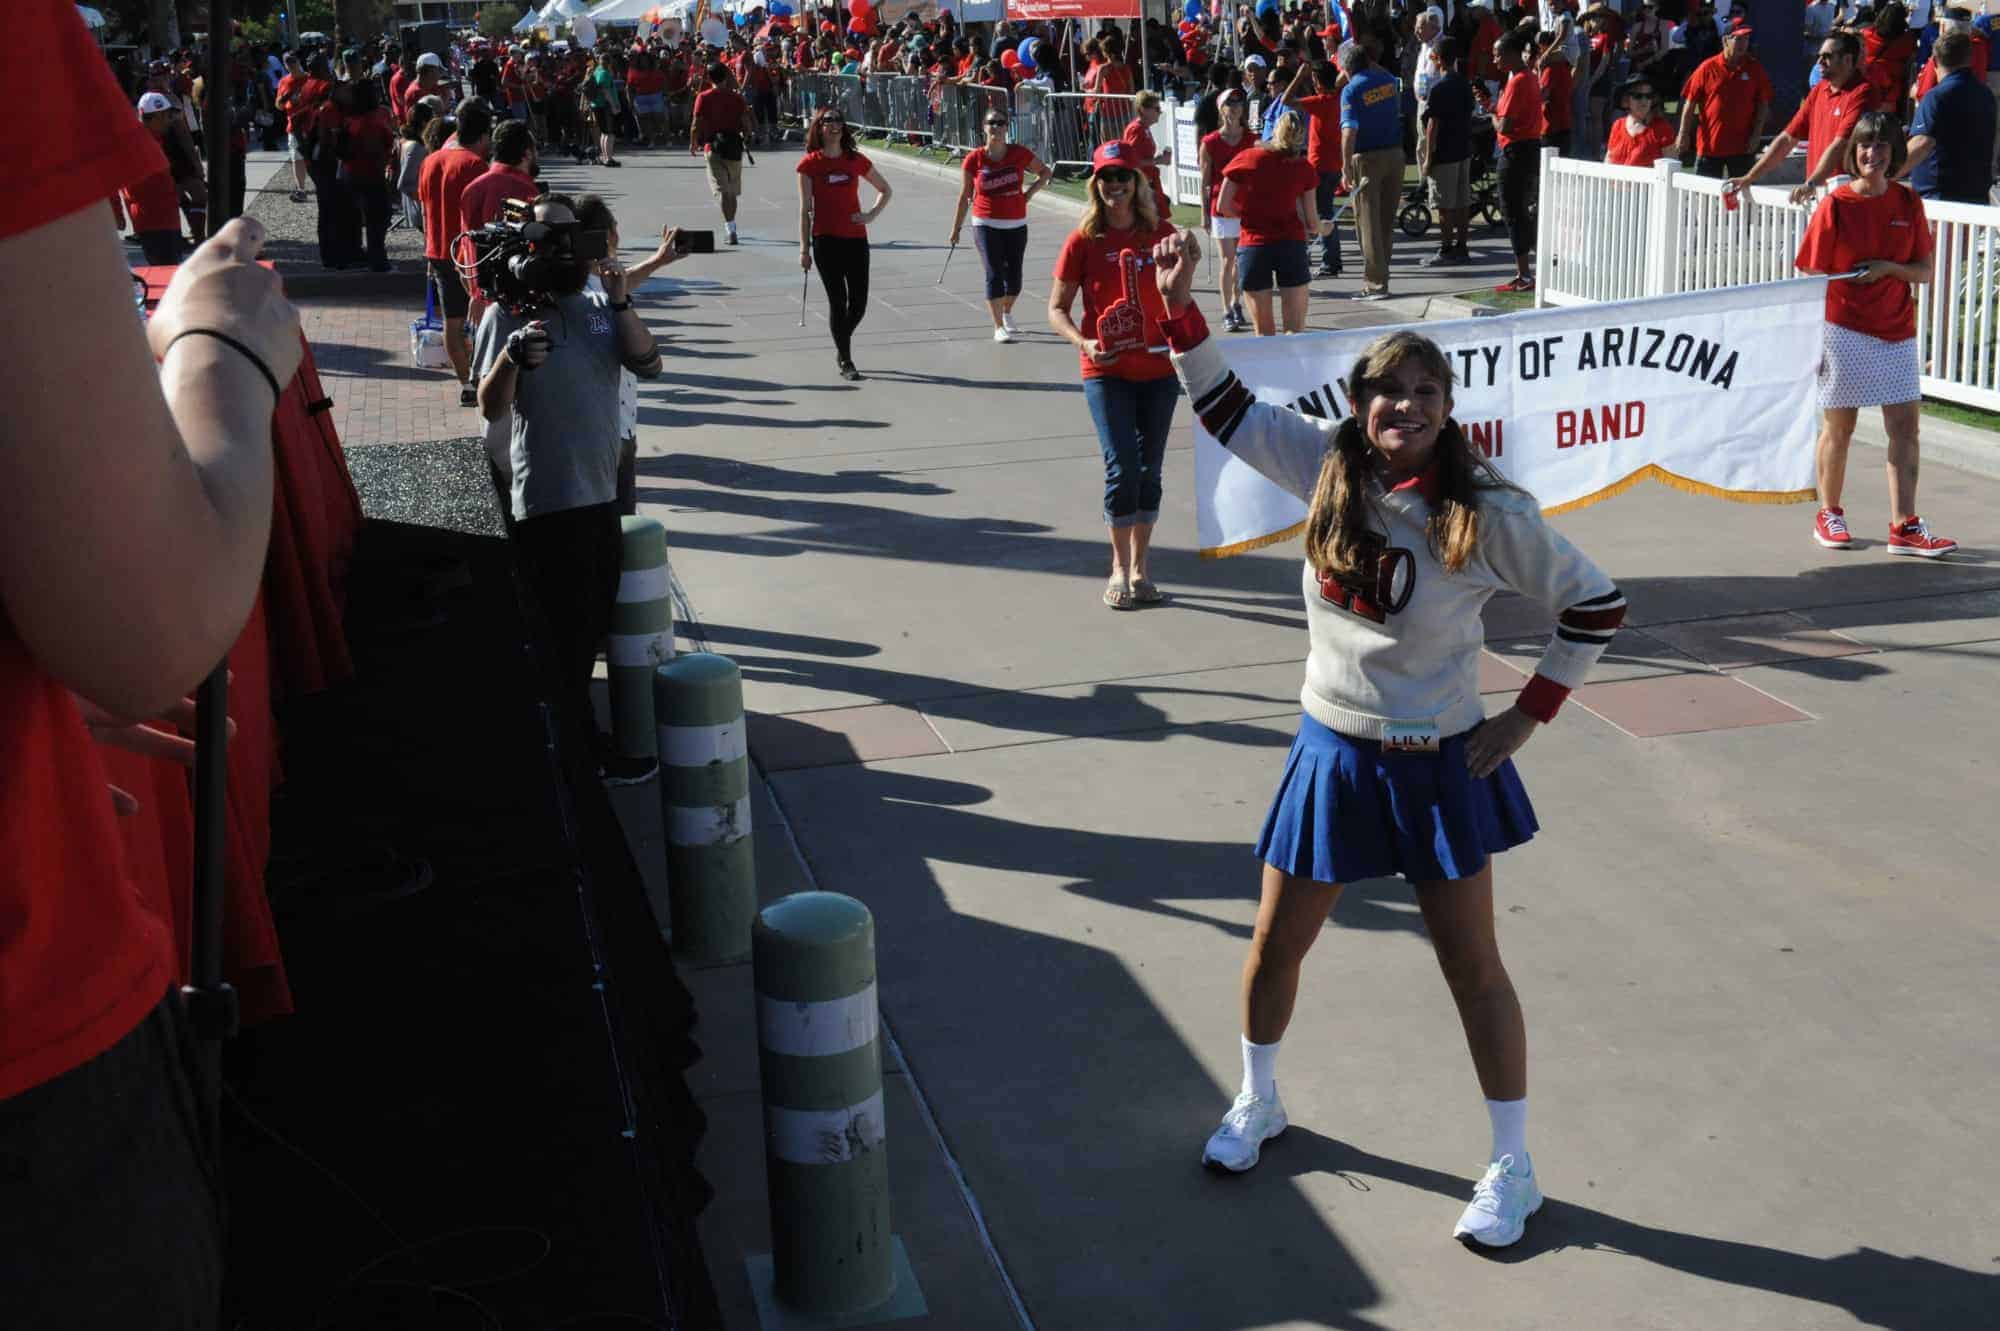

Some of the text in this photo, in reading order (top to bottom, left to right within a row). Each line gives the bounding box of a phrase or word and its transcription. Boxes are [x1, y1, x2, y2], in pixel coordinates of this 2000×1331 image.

[1519, 335, 1563, 380] OF
[1577, 326, 1739, 390] ARIZONA
[1556, 400, 1646, 449] BAND
[1391, 735, 1431, 746] LILY
